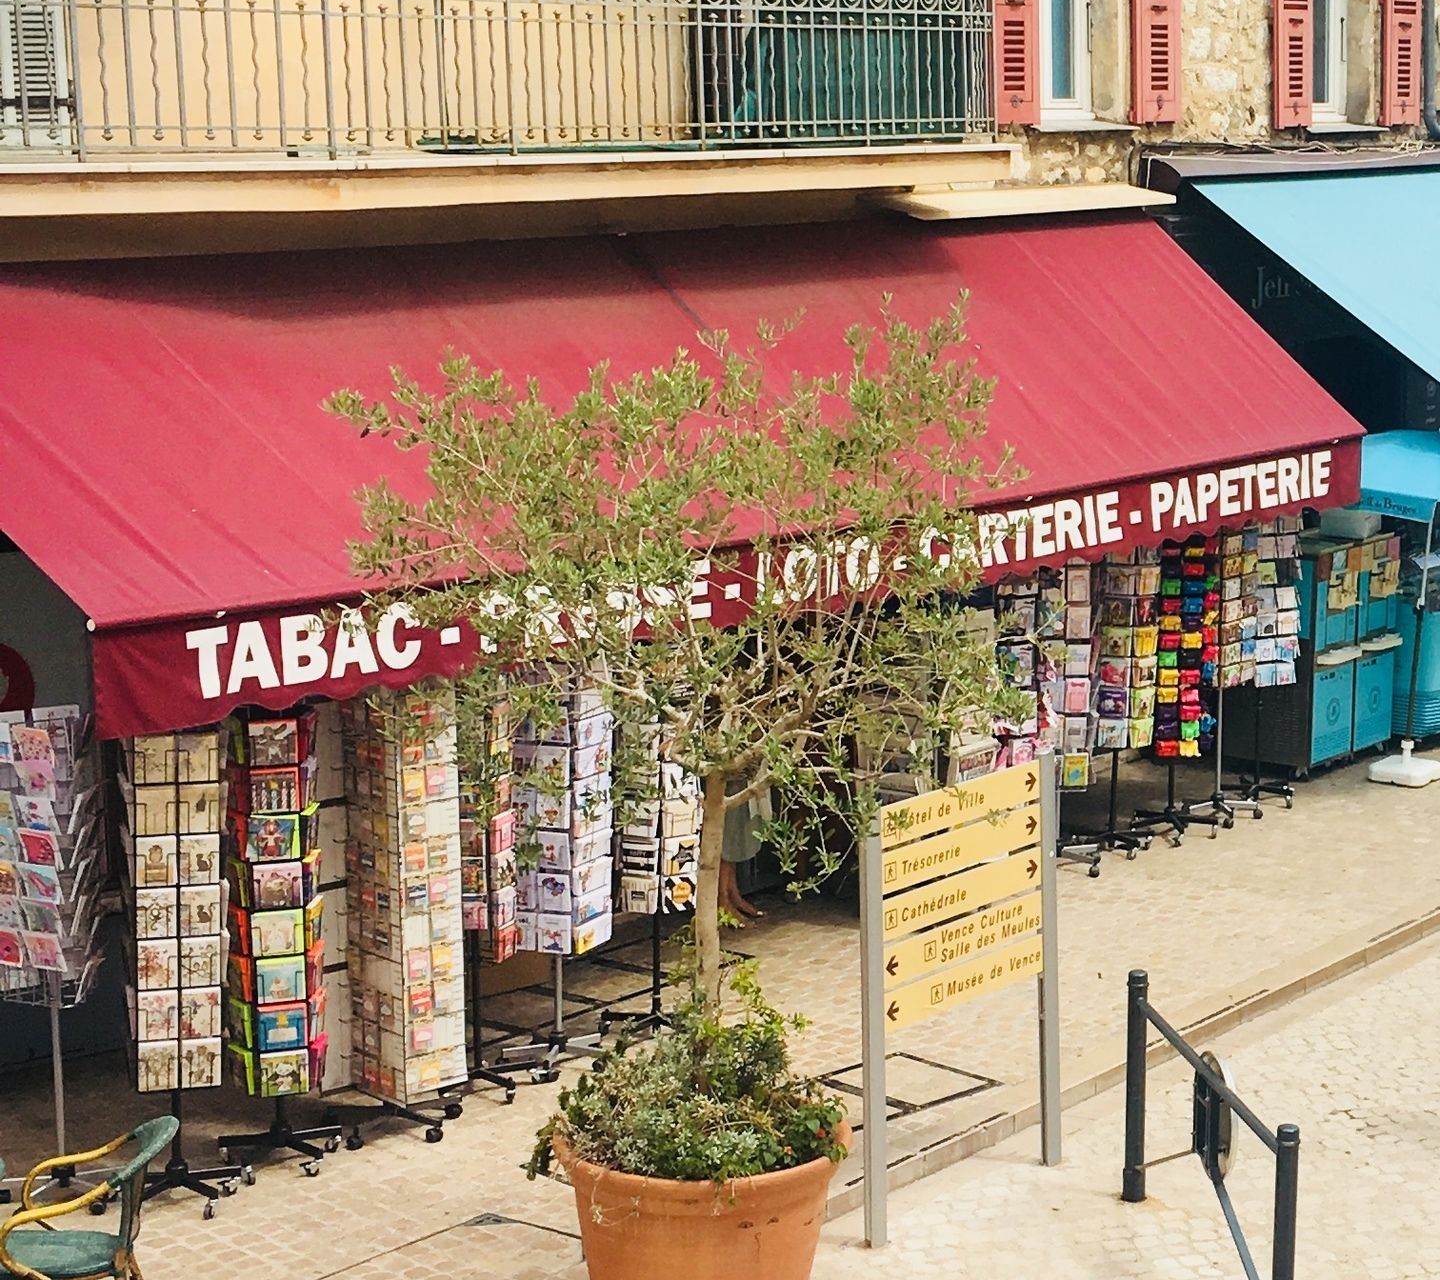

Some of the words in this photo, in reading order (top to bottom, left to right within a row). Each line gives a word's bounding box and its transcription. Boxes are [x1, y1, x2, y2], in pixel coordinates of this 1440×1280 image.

[185, 603, 422, 700] TABAC
[756, 535, 880, 605] LOTO
[919, 491, 1124, 575] CARTERIE
[1150, 450, 1333, 532] PAPETERIE
[903, 806, 933, 827] ôtel
[938, 802, 952, 818] de
[958, 791, 985, 811] Ville
[902, 845, 961, 876] Trésorerie
[902, 888, 967, 922] Cathédrale
[941, 922, 975, 945] Vence
[980, 904, 1024, 930] Culture
[941, 939, 971, 963] Salle
[977, 931, 996, 950] des
[1001, 914, 1041, 939] Meules
[947, 972, 984, 997] Musée
[990, 964, 1003, 979] de
[1010, 950, 1041, 972] Vence
